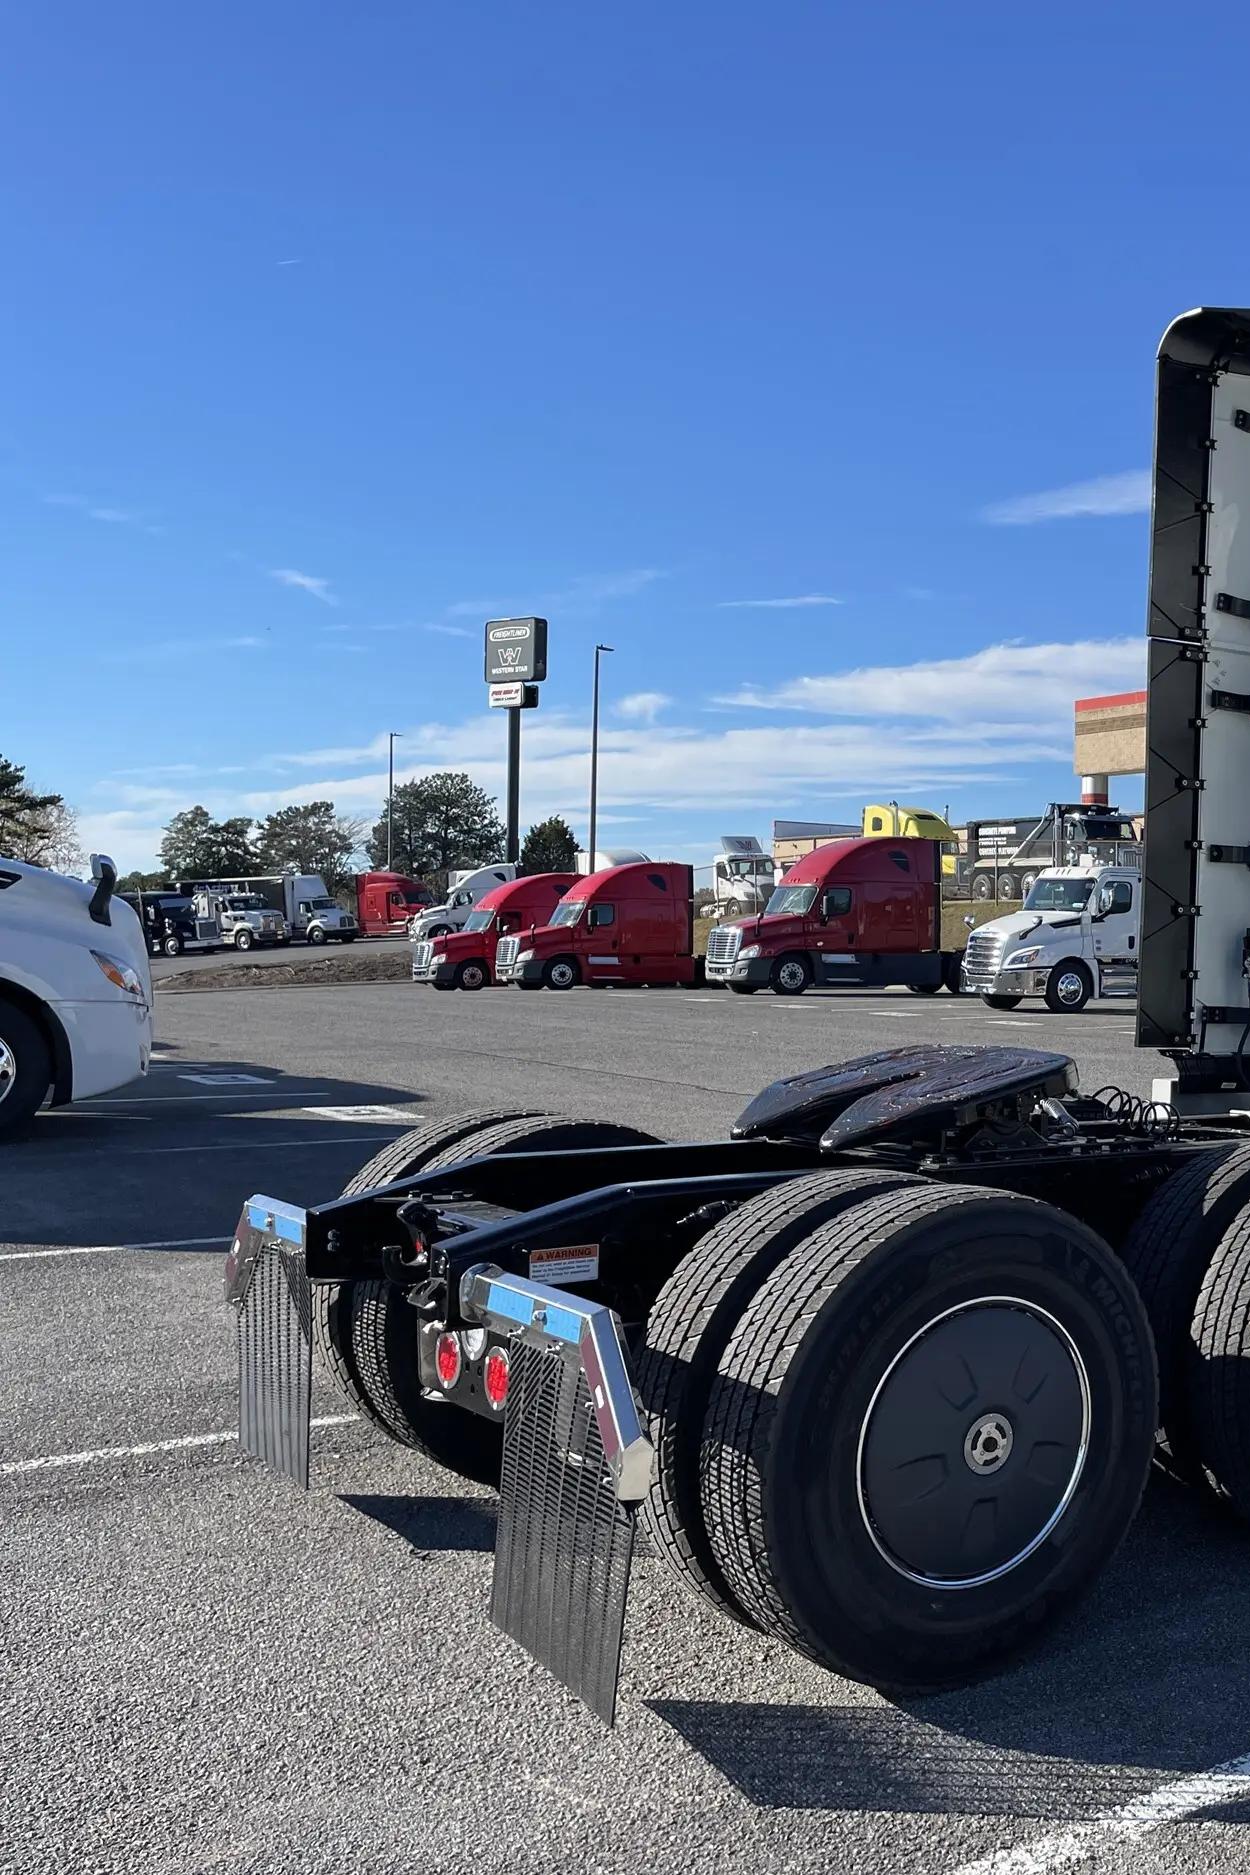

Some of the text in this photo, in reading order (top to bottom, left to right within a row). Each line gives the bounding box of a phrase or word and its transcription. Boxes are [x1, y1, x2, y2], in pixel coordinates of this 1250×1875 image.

[494, 629, 526, 638] FREIGHTLINER
[515, 665, 527, 673] STAR
[546, 1248, 592, 1260] WARNING
